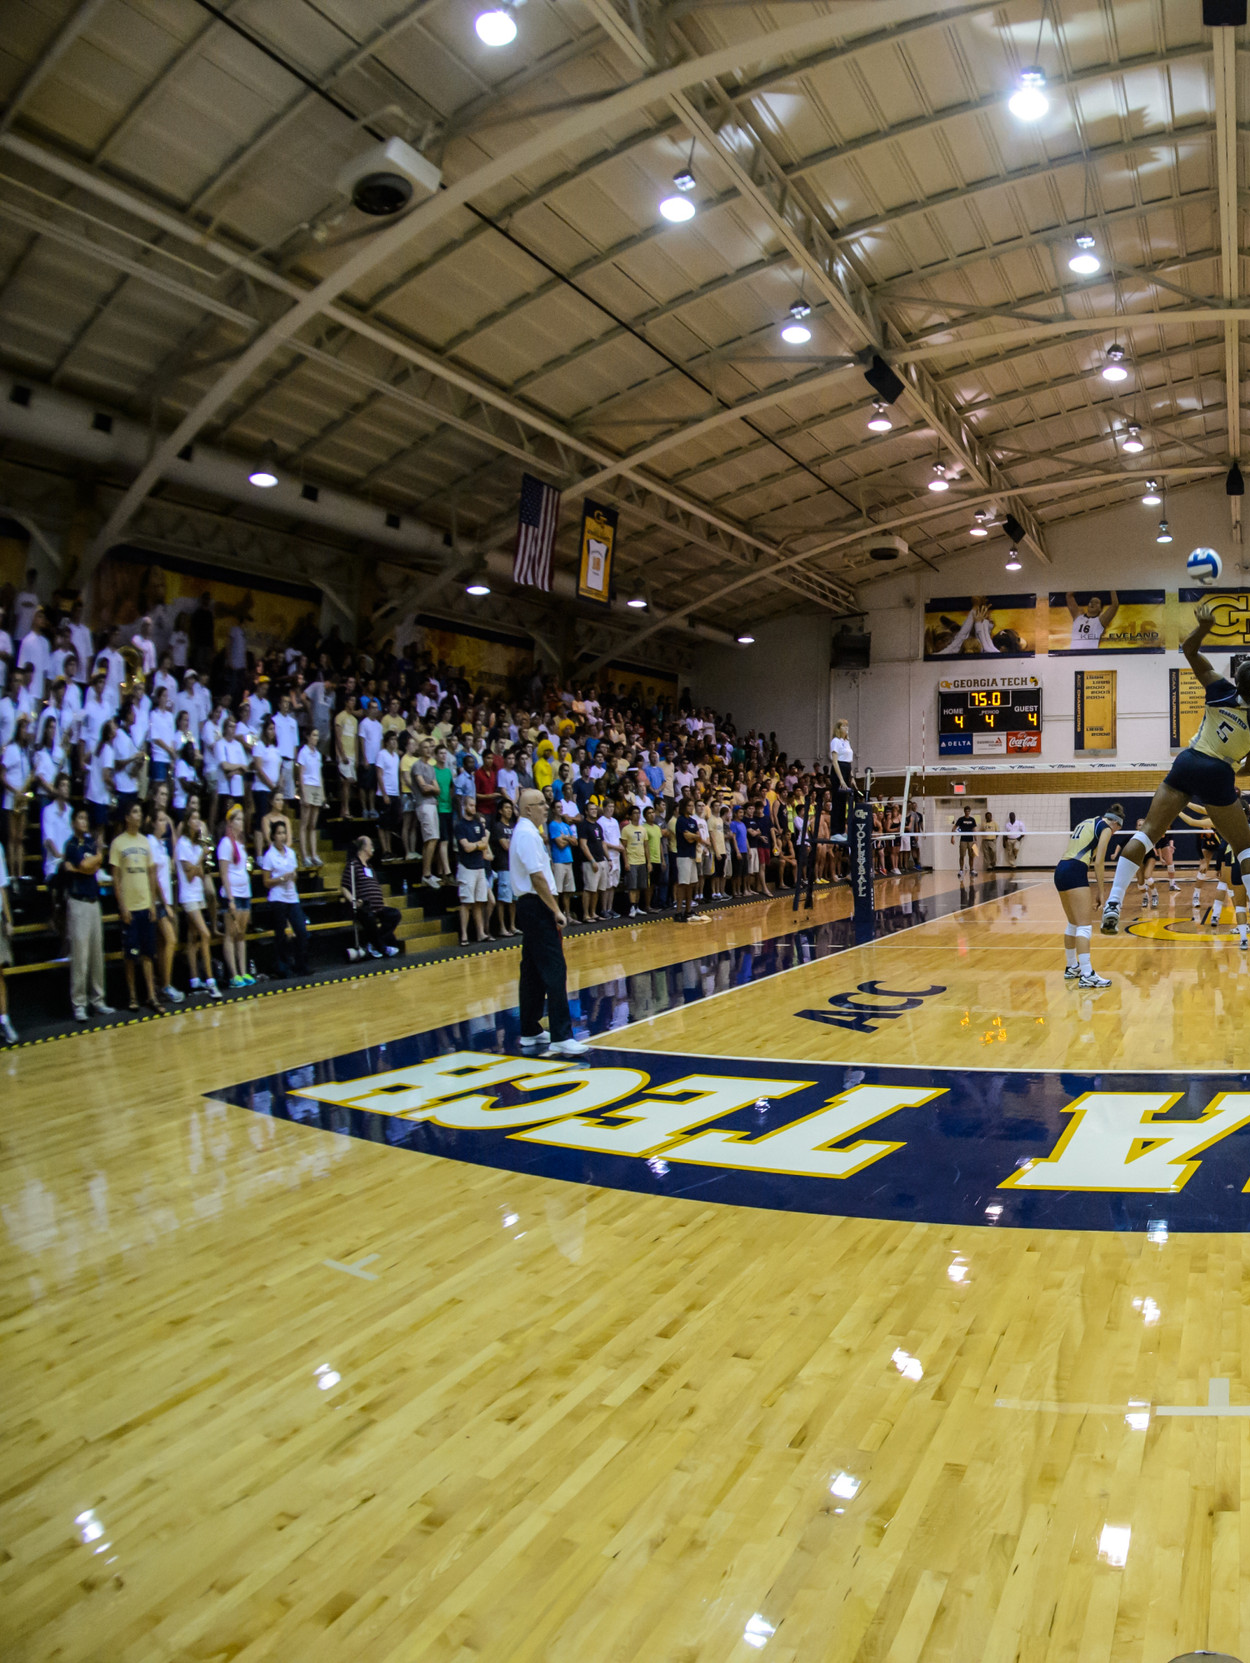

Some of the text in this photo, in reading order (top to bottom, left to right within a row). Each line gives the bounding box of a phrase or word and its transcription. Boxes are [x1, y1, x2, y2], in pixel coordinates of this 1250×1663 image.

[1078, 624, 1090, 634] 16
[953, 679, 998, 688] GEORGIA
[1000, 677, 1028, 687] TECH
[971, 691, 1001, 706] 75.0
[954, 715, 964, 729] 4
[985, 714, 994, 728] 4
[1028, 713, 1037, 726] 4
[1216, 721, 1234, 744] 5
[1072, 825, 1084, 839] 11
[856, 823, 867, 897] VOLLEYBALL
[793, 980, 947, 1034] ACC
[286, 1051, 950, 1179] TECH
